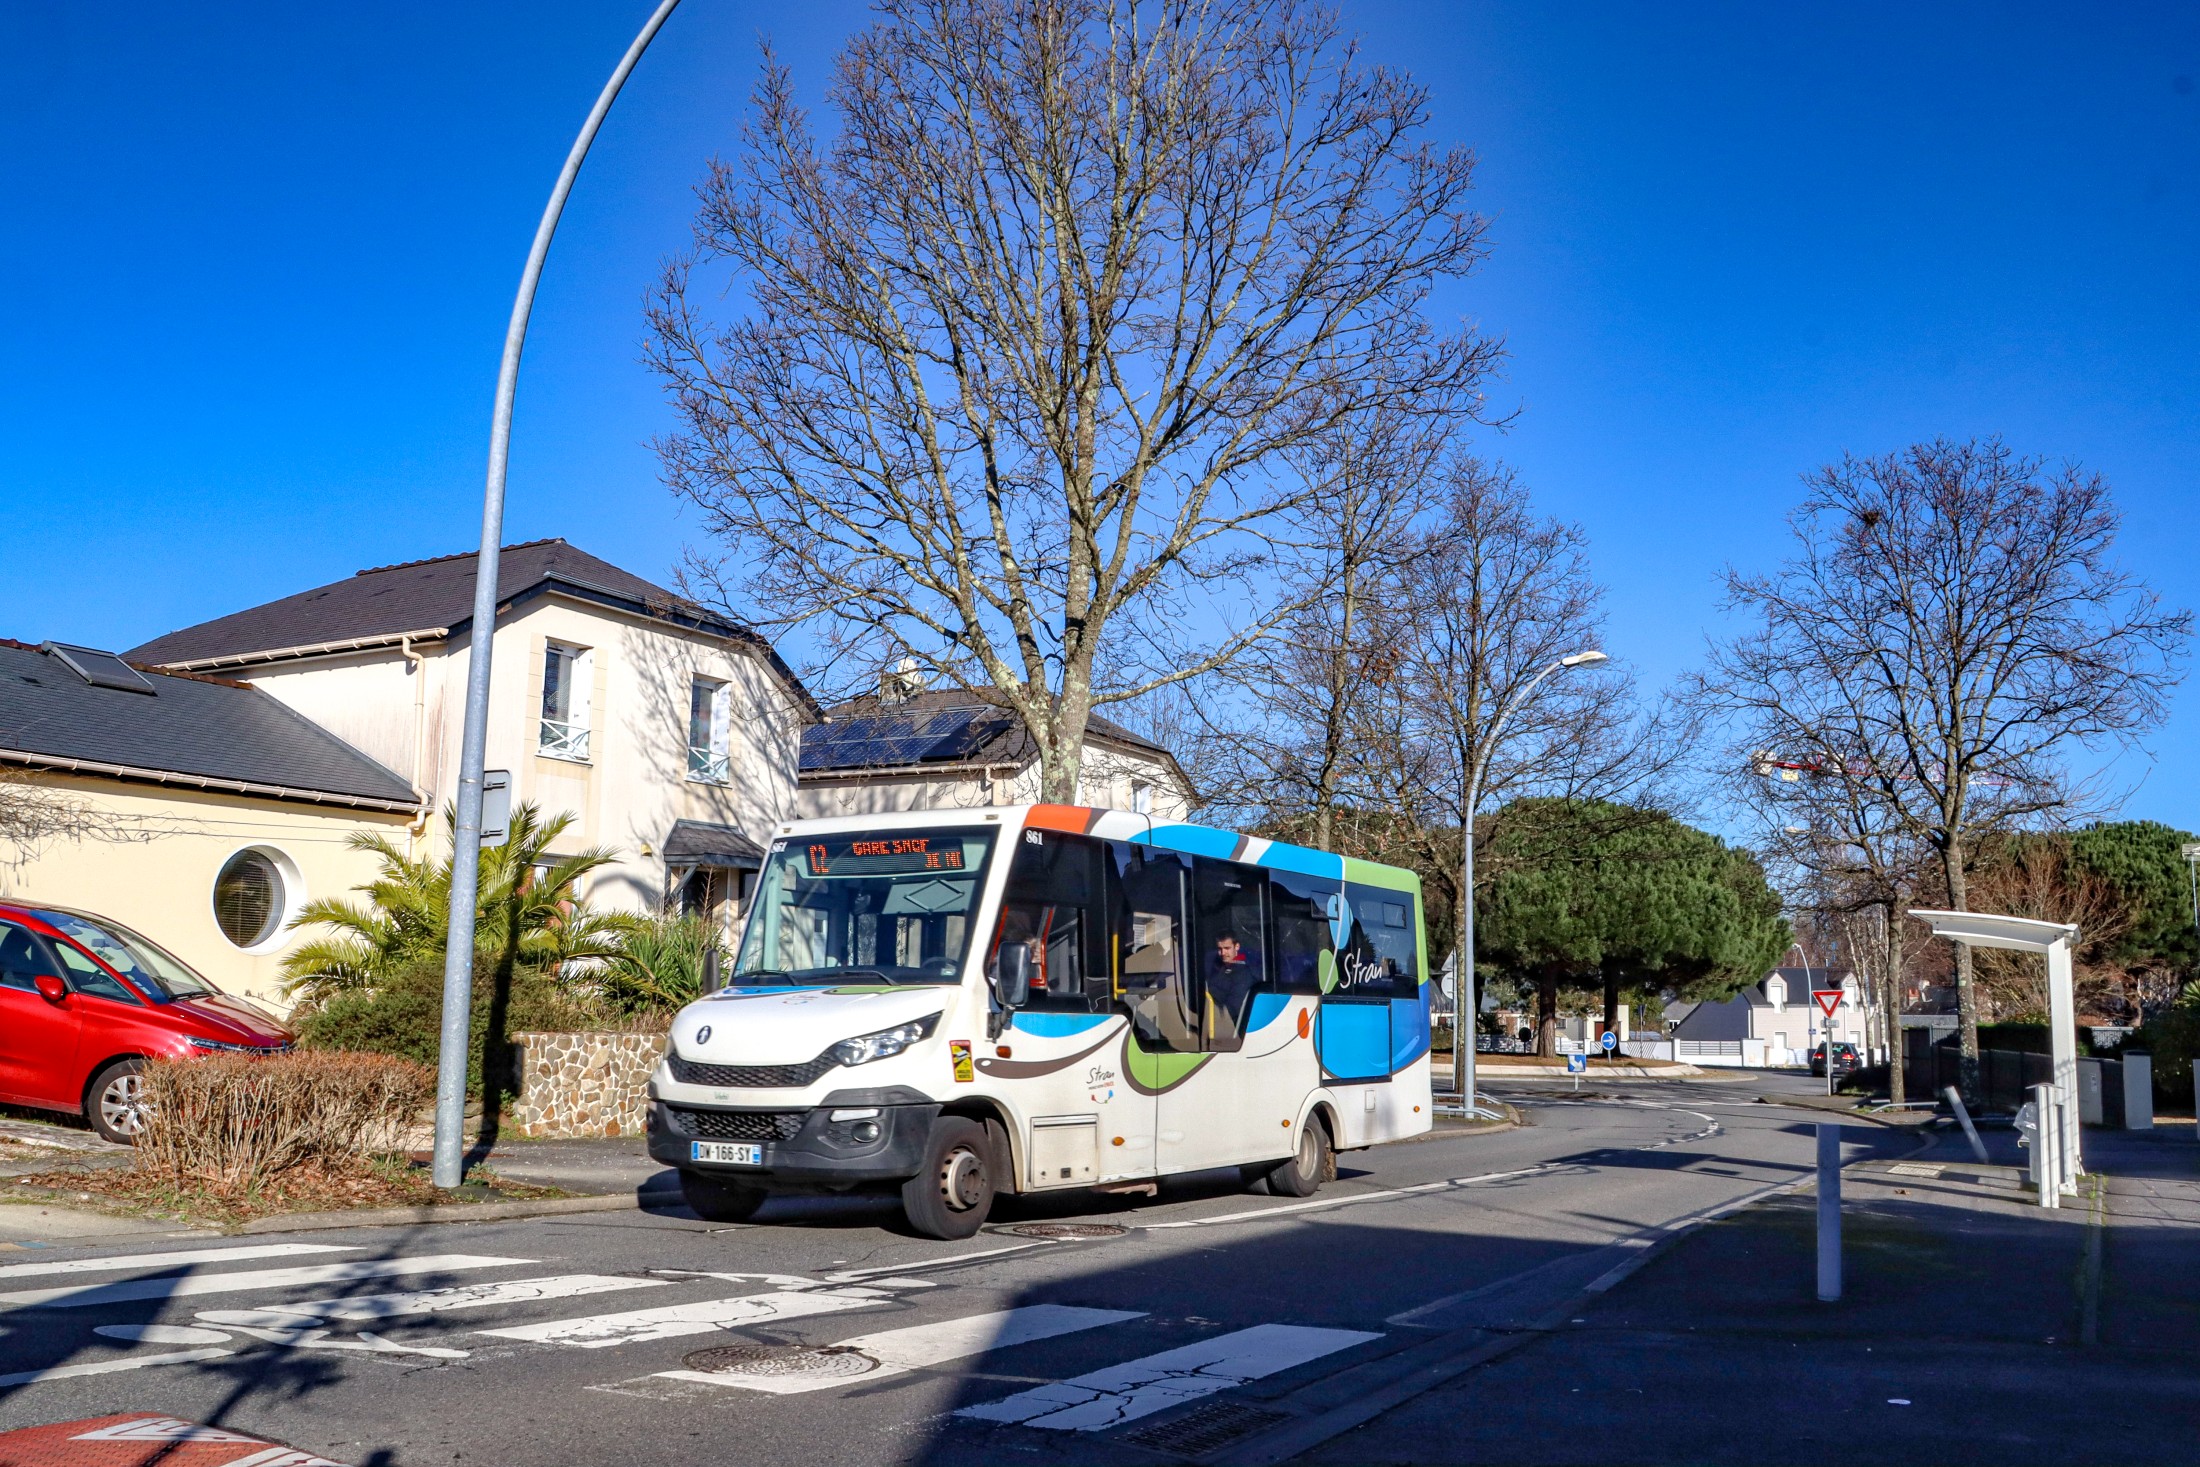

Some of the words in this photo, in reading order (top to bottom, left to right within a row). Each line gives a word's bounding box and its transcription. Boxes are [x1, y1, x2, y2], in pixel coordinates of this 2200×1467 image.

[1026, 829, 1043, 845] 861
[852, 841, 890, 856] GARE
[1340, 947, 1382, 989] Stran
[1086, 1064, 1115, 1084] Stran
[699, 1144, 751, 1162] DW-166-SY
